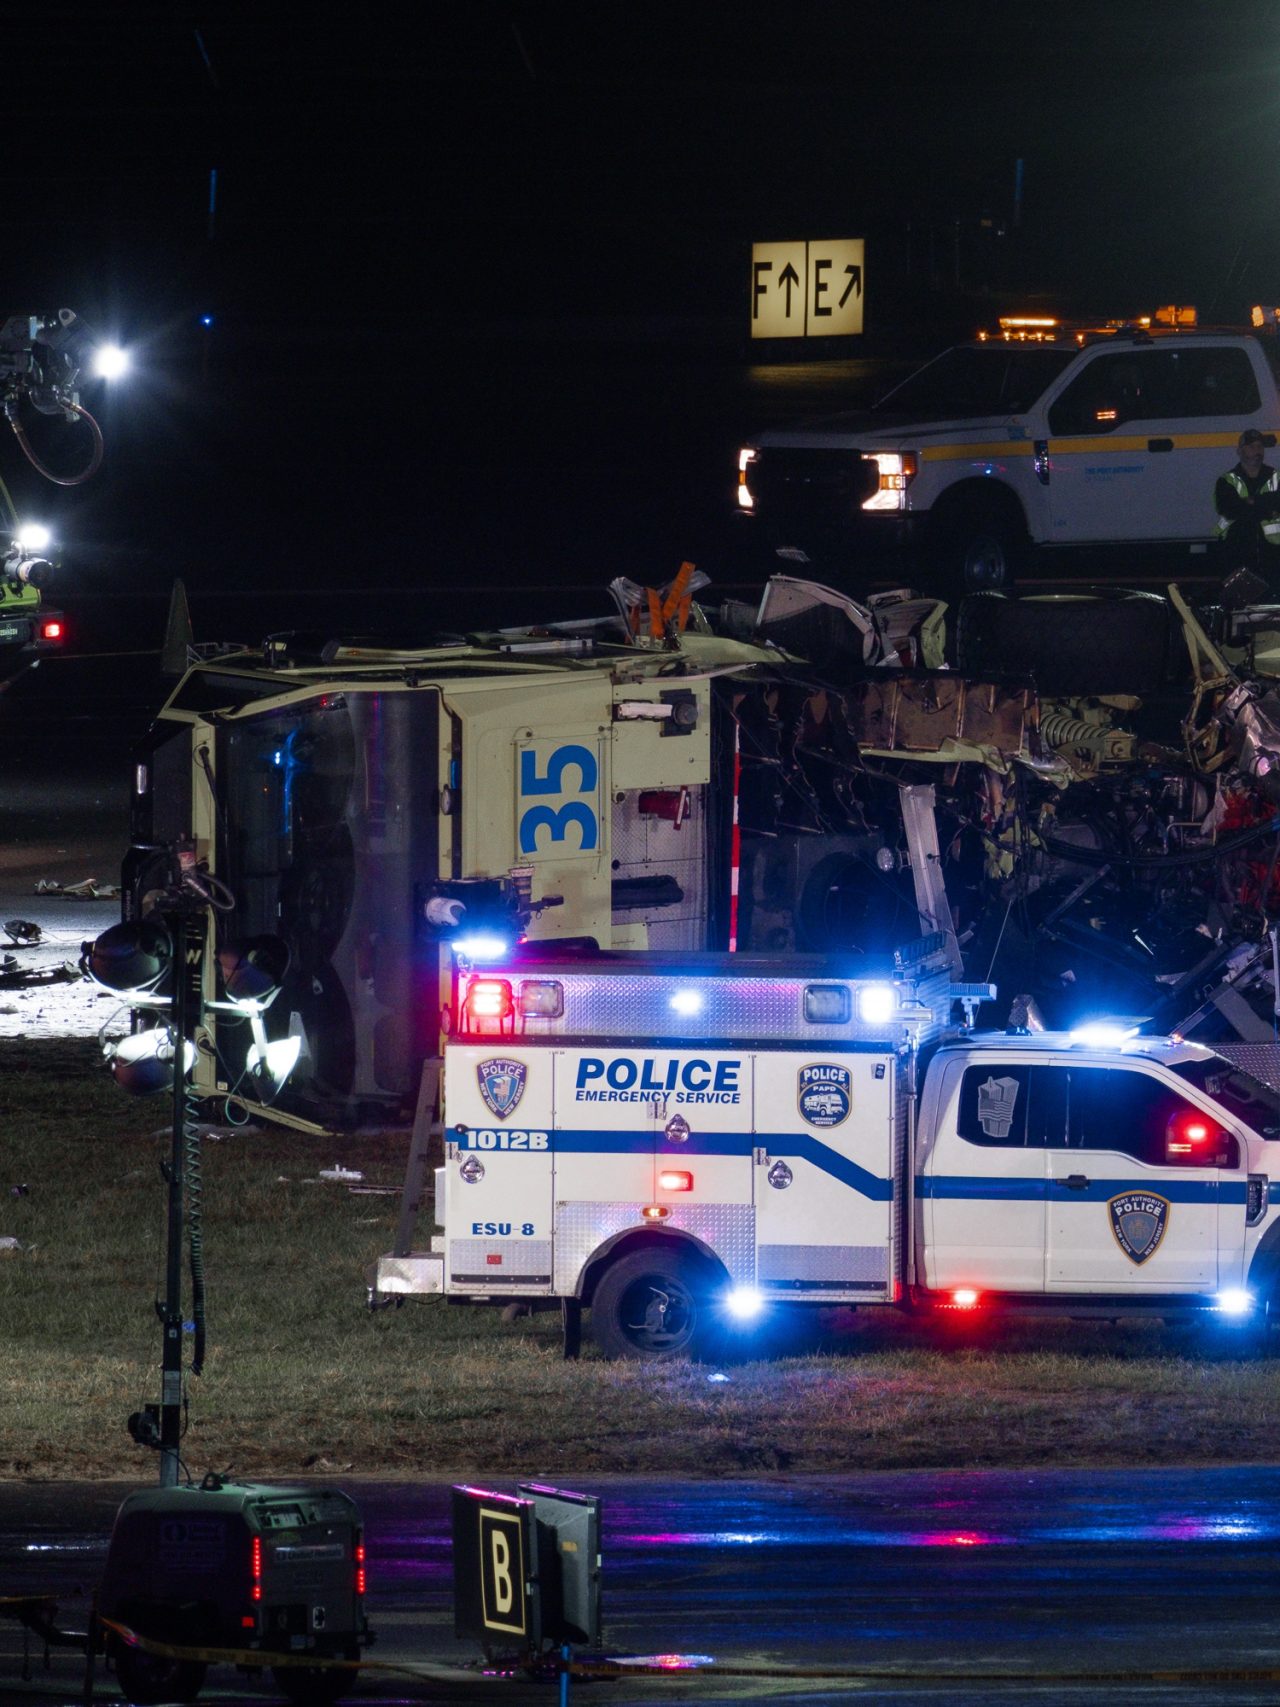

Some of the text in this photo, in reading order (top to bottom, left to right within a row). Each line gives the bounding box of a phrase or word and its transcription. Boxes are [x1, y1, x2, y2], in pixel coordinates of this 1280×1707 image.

[753, 262, 772, 319] F
[814, 259, 832, 316] E
[520, 744, 598, 854] 35
[482, 1064, 523, 1078] POLICE
[576, 1057, 741, 1092] POLICE
[804, 1068, 846, 1081] POLICE
[576, 1090, 741, 1104] EMERGENCY SERVICE
[465, 1130, 548, 1150] 1012B
[1113, 1196, 1165, 1208] PORT AUTHORITY
[1115, 1202, 1162, 1216] POLICE
[472, 1222, 535, 1236] ESU-8
[1120, 1238, 1132, 1253] YORK
[1144, 1222, 1163, 1255] NEW JERSEY
[491, 1529, 512, 1613] B
